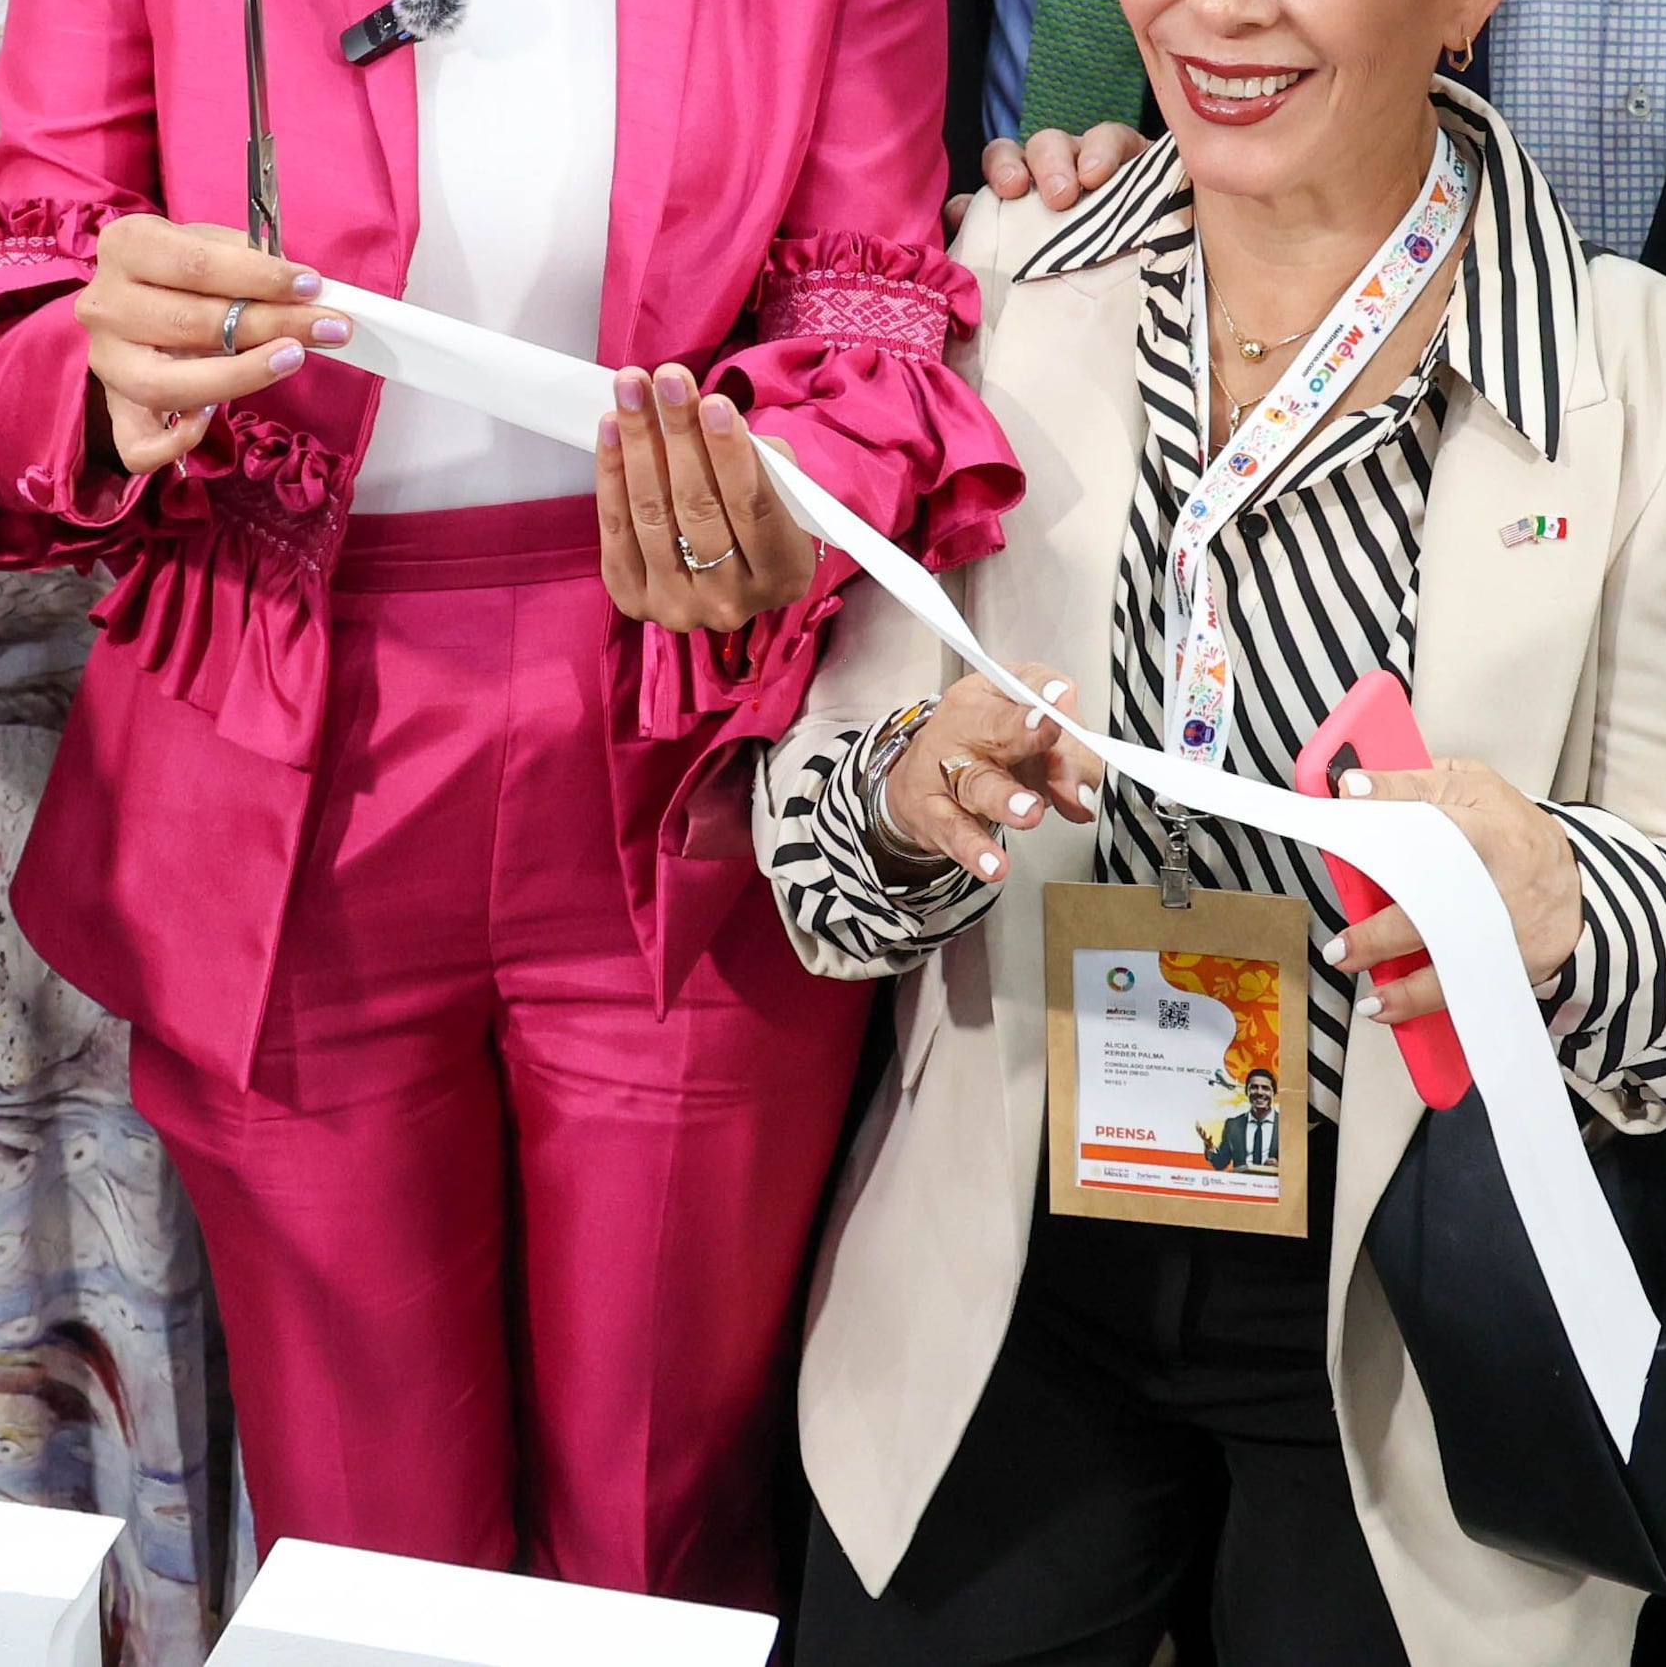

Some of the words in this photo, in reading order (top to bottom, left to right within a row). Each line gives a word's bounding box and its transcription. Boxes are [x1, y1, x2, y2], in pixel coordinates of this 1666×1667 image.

[1104, 1041, 1129, 1049] ALICIA
[1138, 1052, 1164, 1060] PALMA
[1095, 1125, 1157, 1142] PRENSA
